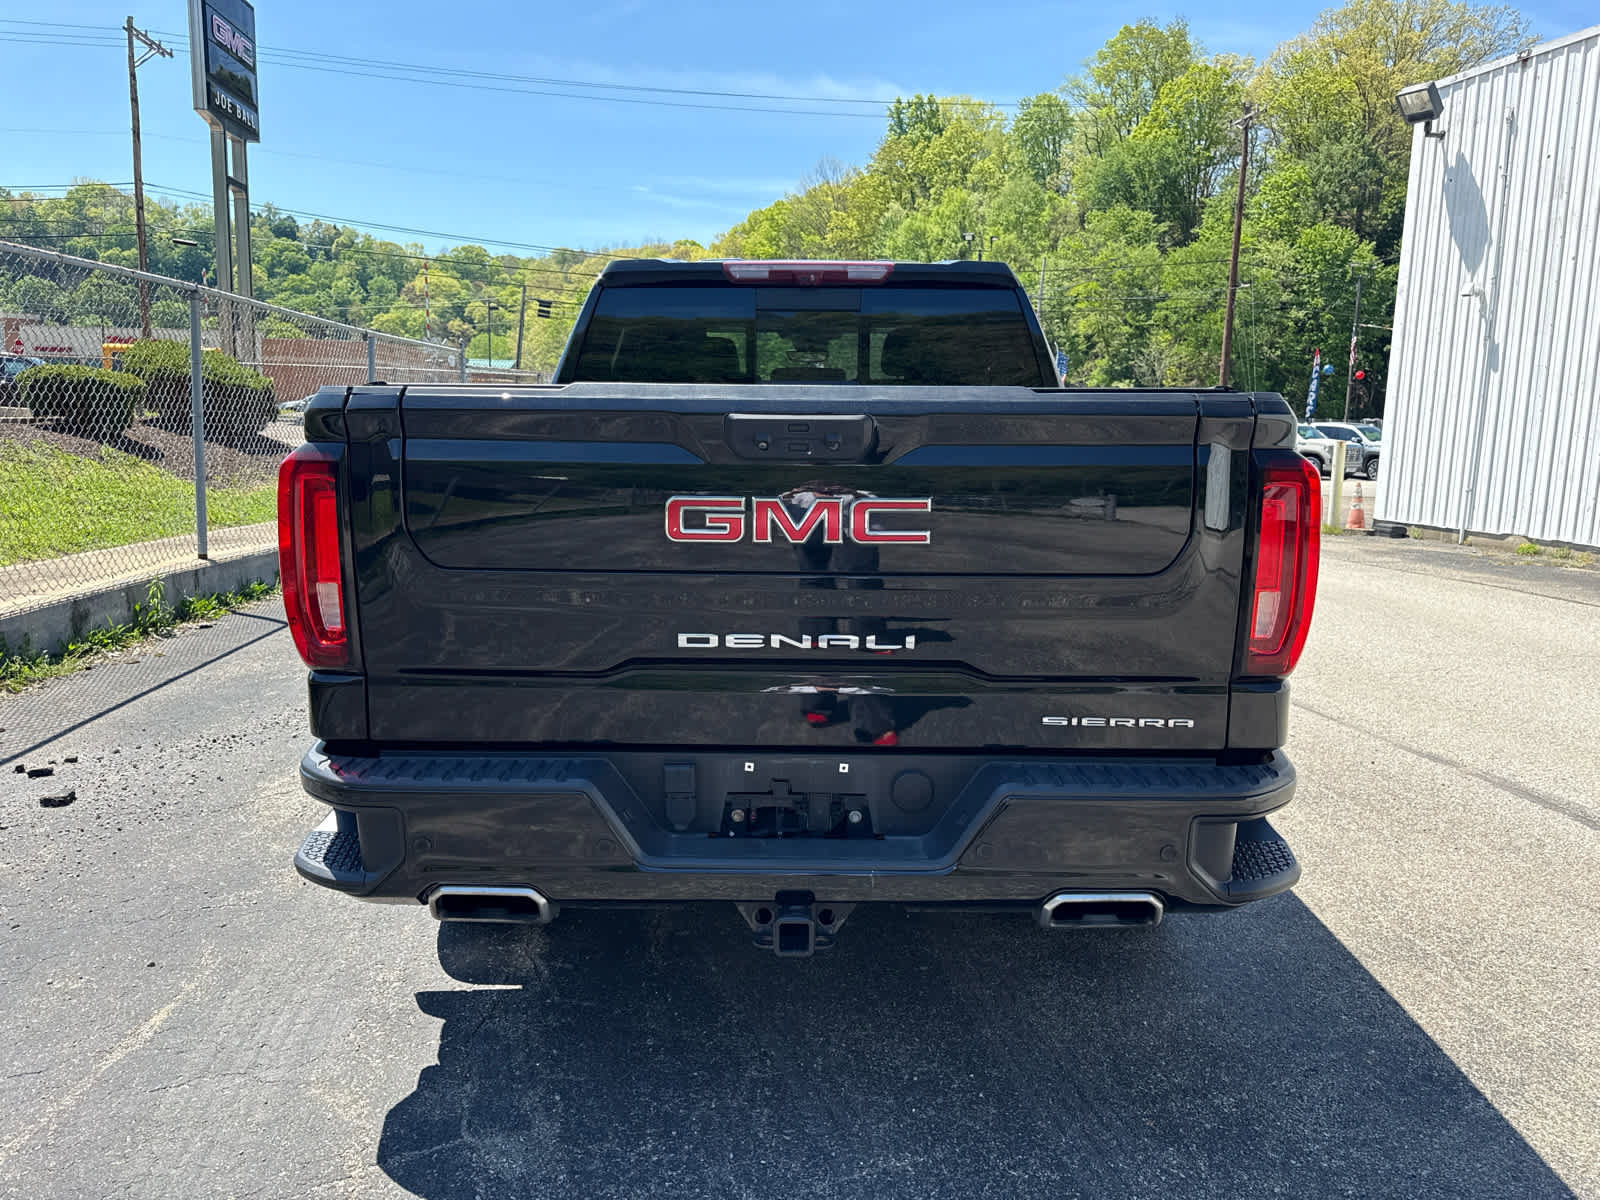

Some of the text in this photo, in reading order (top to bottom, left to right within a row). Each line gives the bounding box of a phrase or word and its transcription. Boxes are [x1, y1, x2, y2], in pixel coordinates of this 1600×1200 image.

[212, 14, 254, 67] GMC
[215, 90, 256, 129] JOE BALL
[665, 495, 932, 544] GMC
[677, 633, 916, 650] DENALI
[1041, 716, 1195, 728] SIERRA
